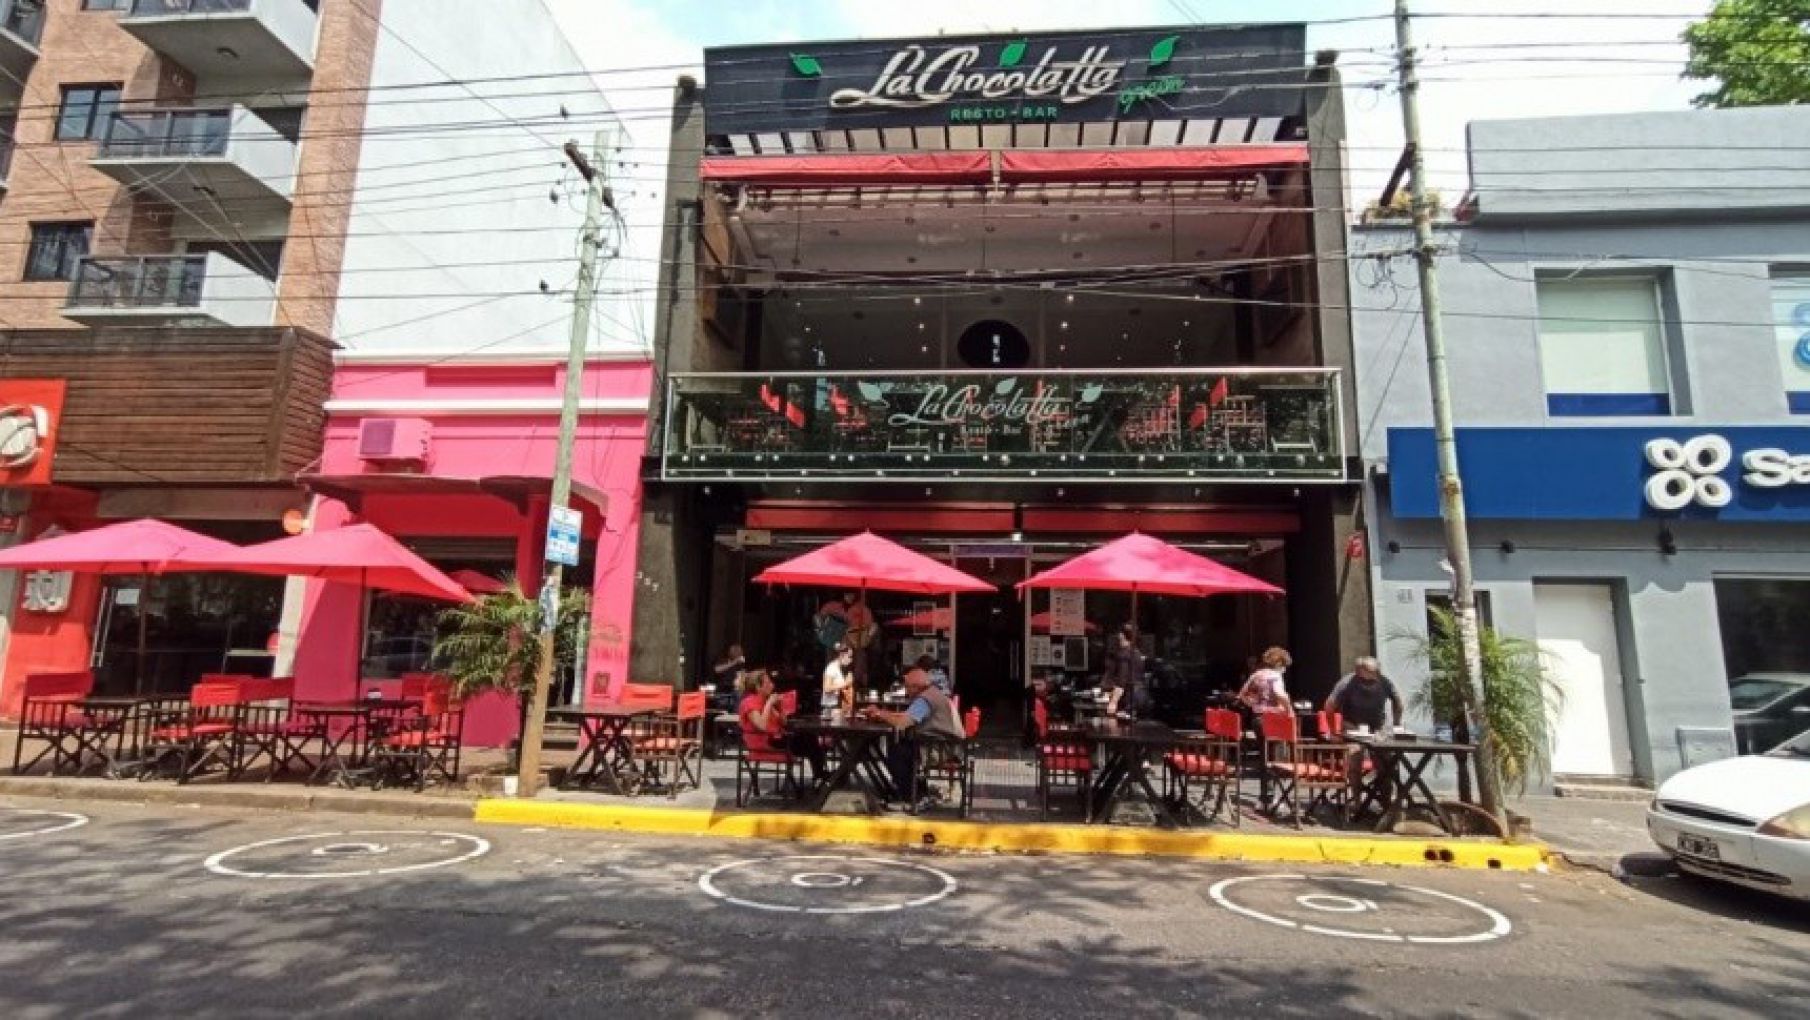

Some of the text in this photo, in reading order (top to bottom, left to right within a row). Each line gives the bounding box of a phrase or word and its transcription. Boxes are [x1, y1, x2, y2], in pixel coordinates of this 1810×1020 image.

[916, 46, 1126, 104] Chocolatta
[950, 107, 1006, 121] RESTO
[1022, 105, 1058, 118] BAR
